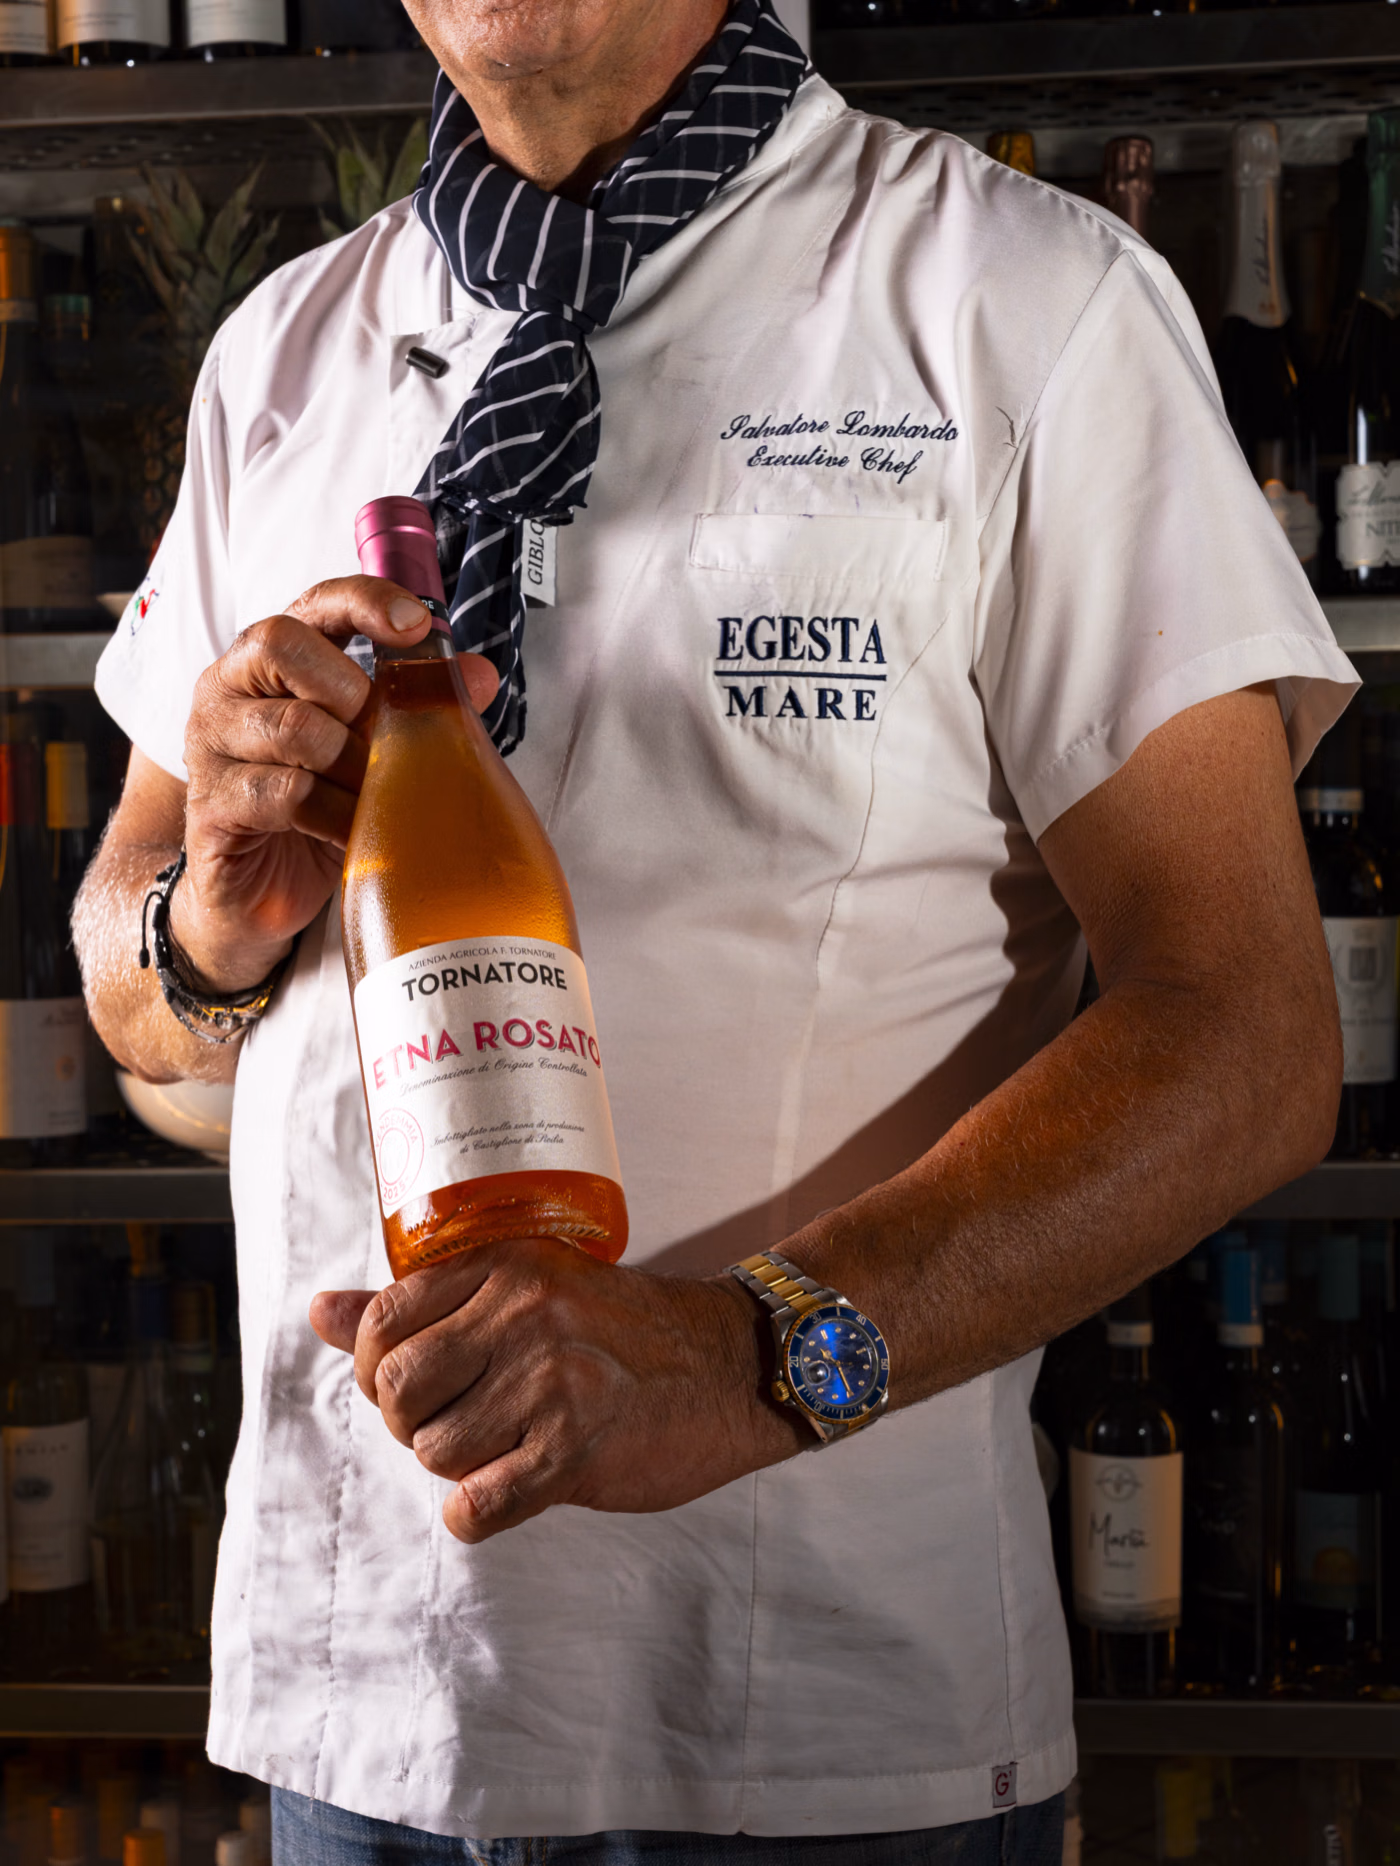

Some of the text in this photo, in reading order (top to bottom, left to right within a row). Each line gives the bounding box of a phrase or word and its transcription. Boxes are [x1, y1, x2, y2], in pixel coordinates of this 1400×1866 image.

[721, 410, 959, 441] Salvatore Lombardo
[747, 445, 923, 484] Executive Chef
[717, 616, 887, 664] EGESTA
[723, 685, 877, 720] MARE
[408, 954, 447, 971] AZIENDA
[450, 947, 498, 960] AGRICOLA
[510, 947, 557, 961] TORNATORE
[402, 962, 567, 1001] TORNATORE
[373, 1018, 601, 1091] ETNA ROSATO
[478, 1061, 490, 1073] di
[494, 1057, 534, 1072] Origine
[538, 1057, 587, 1076] Controllata
[489, 1121, 512, 1133] nella
[536, 1120, 545, 1129] di
[460, 1145, 469, 1154] di
[524, 1134, 534, 1143] di
[856, 1314, 867, 1326] 40
[789, 1356, 799, 1368] 20
